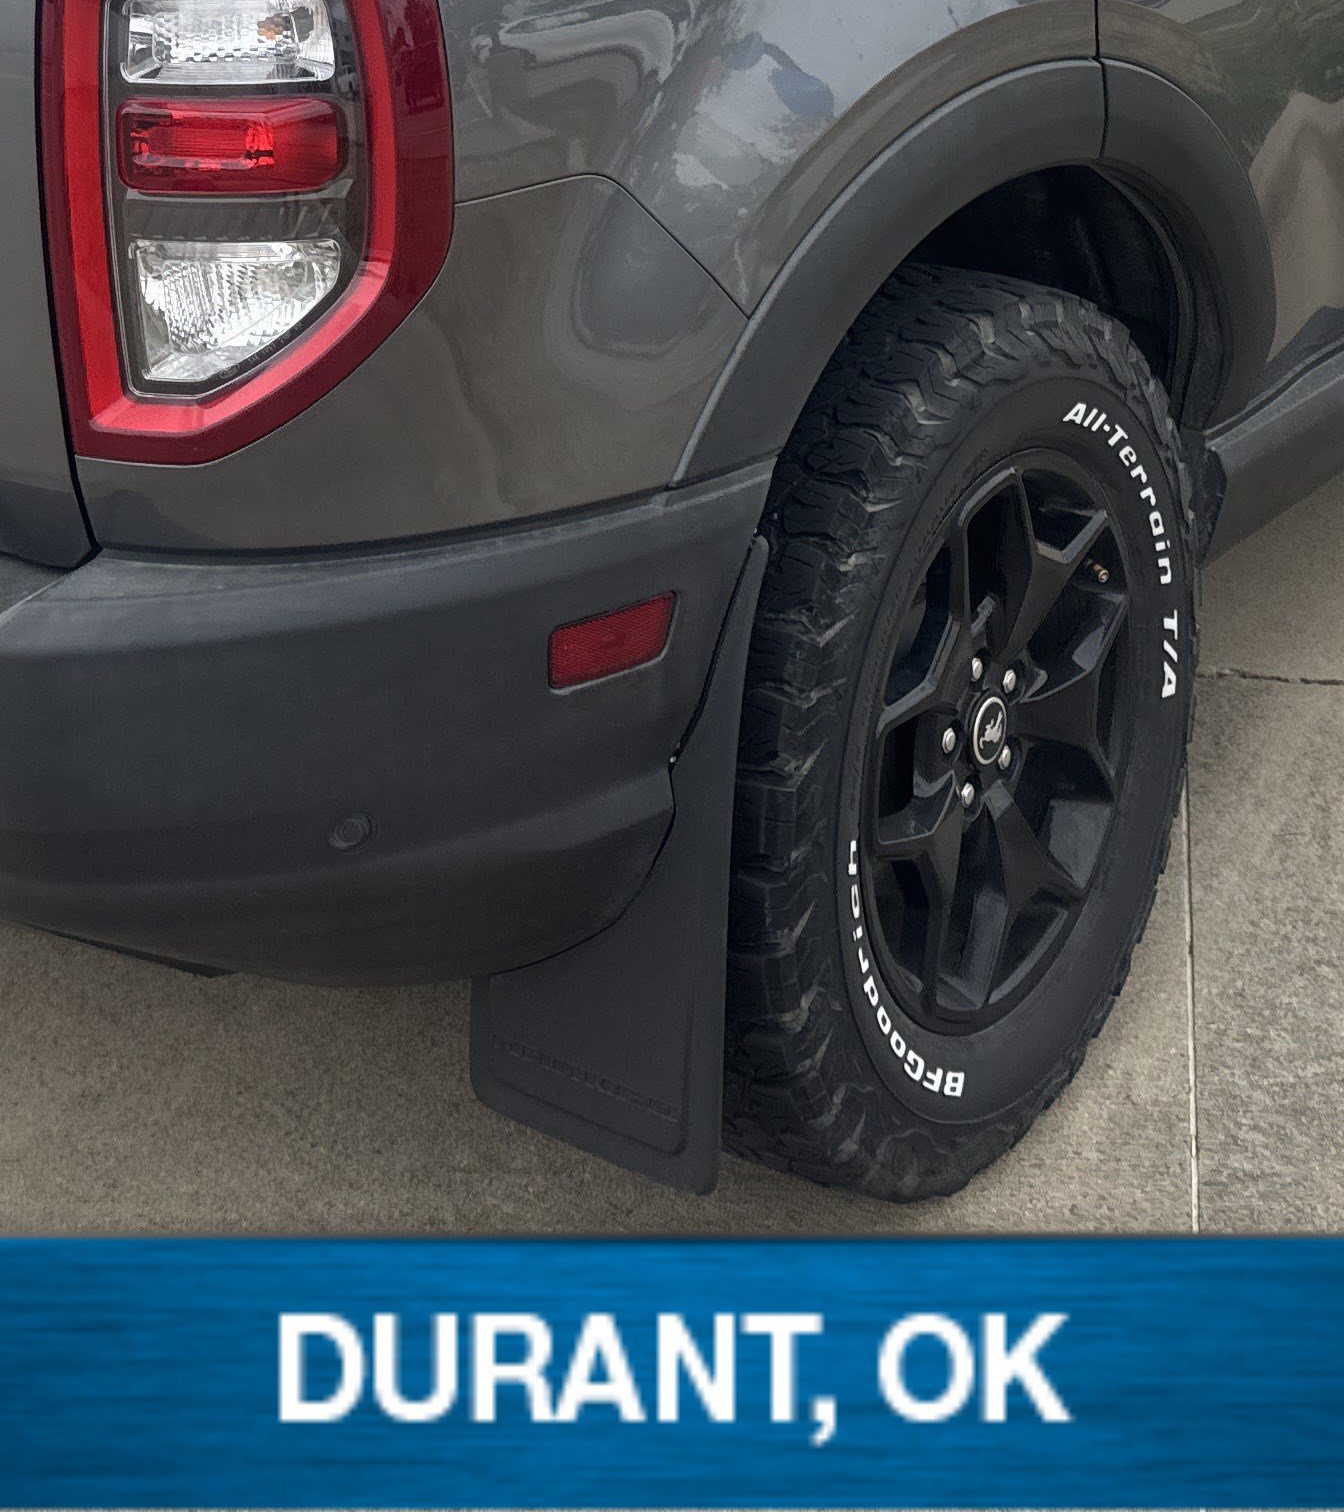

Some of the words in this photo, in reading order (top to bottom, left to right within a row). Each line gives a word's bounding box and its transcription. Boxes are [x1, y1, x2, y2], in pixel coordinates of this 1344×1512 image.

[1062, 402, 1173, 585] All-Terrain
[1160, 609, 1179, 700] T/A
[848, 839, 966, 1098] BFGoodrich
